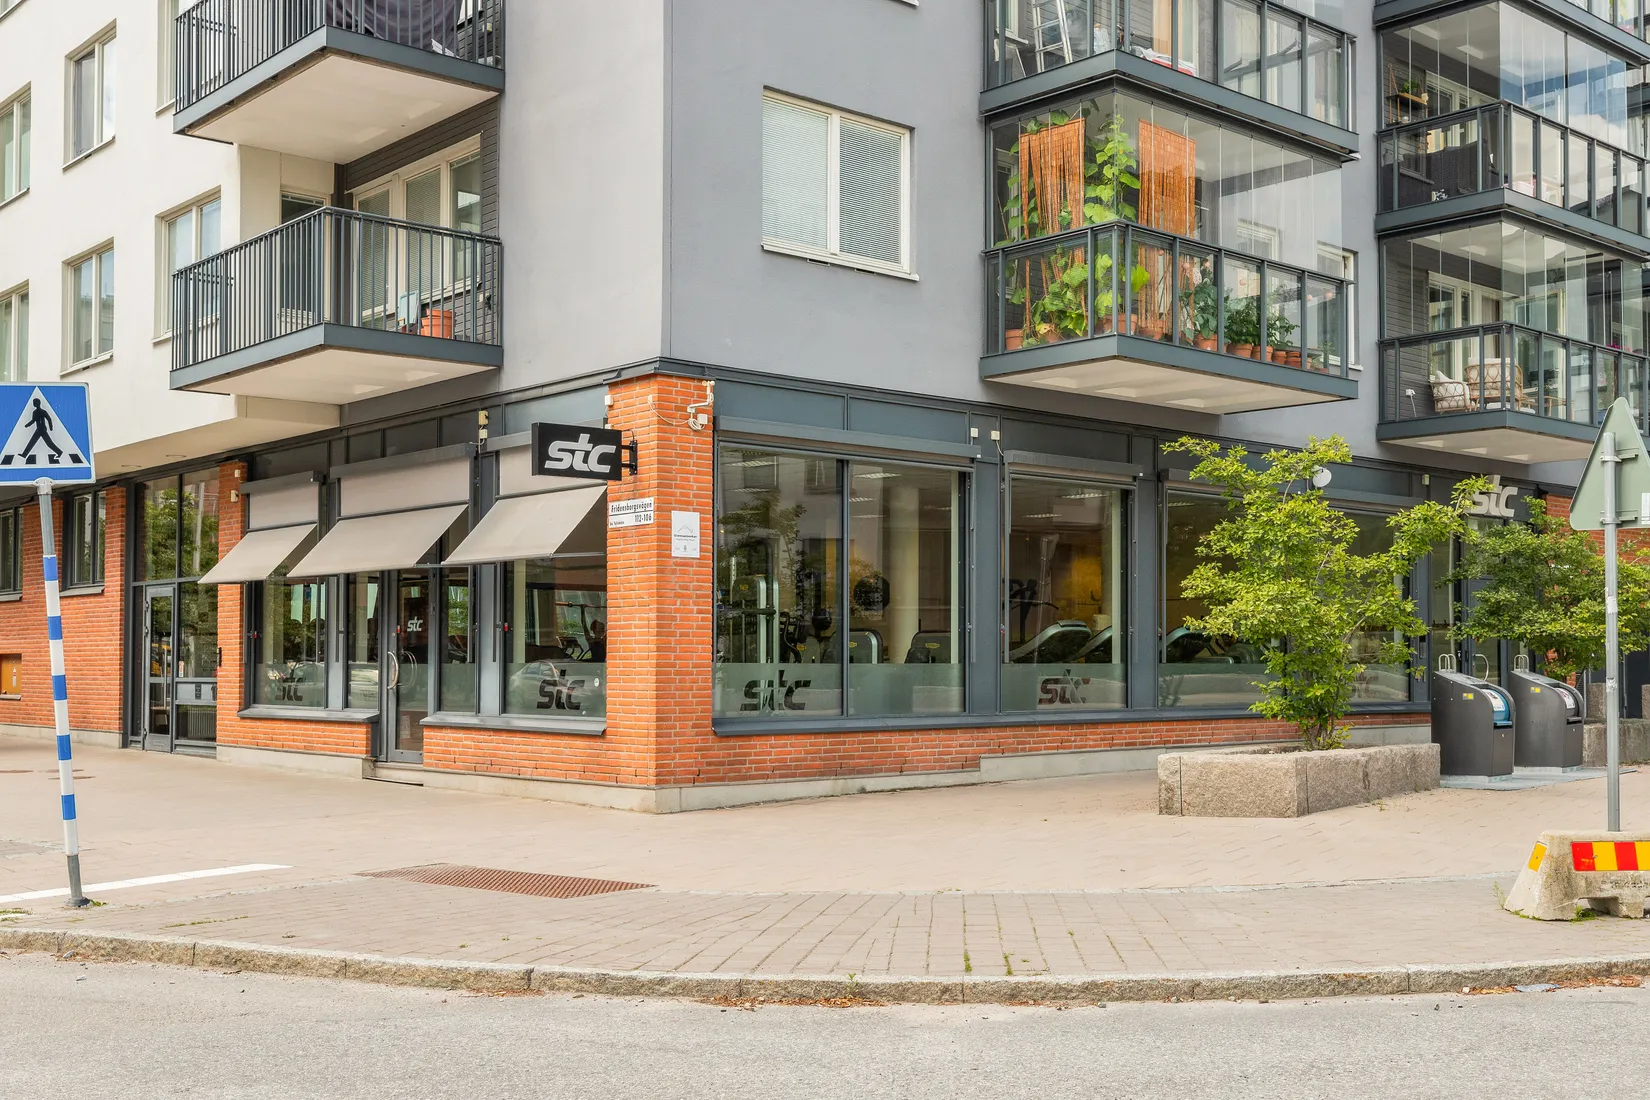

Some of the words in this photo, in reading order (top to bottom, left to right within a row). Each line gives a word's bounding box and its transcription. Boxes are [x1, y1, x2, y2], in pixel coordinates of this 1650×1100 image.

[544, 433, 617, 473] stc
[1466, 474, 1518, 517] stc
[407, 616, 423, 631] stc
[536, 669, 585, 710] stc
[740, 669, 812, 711] stc
[1038, 668, 1092, 705] stc
